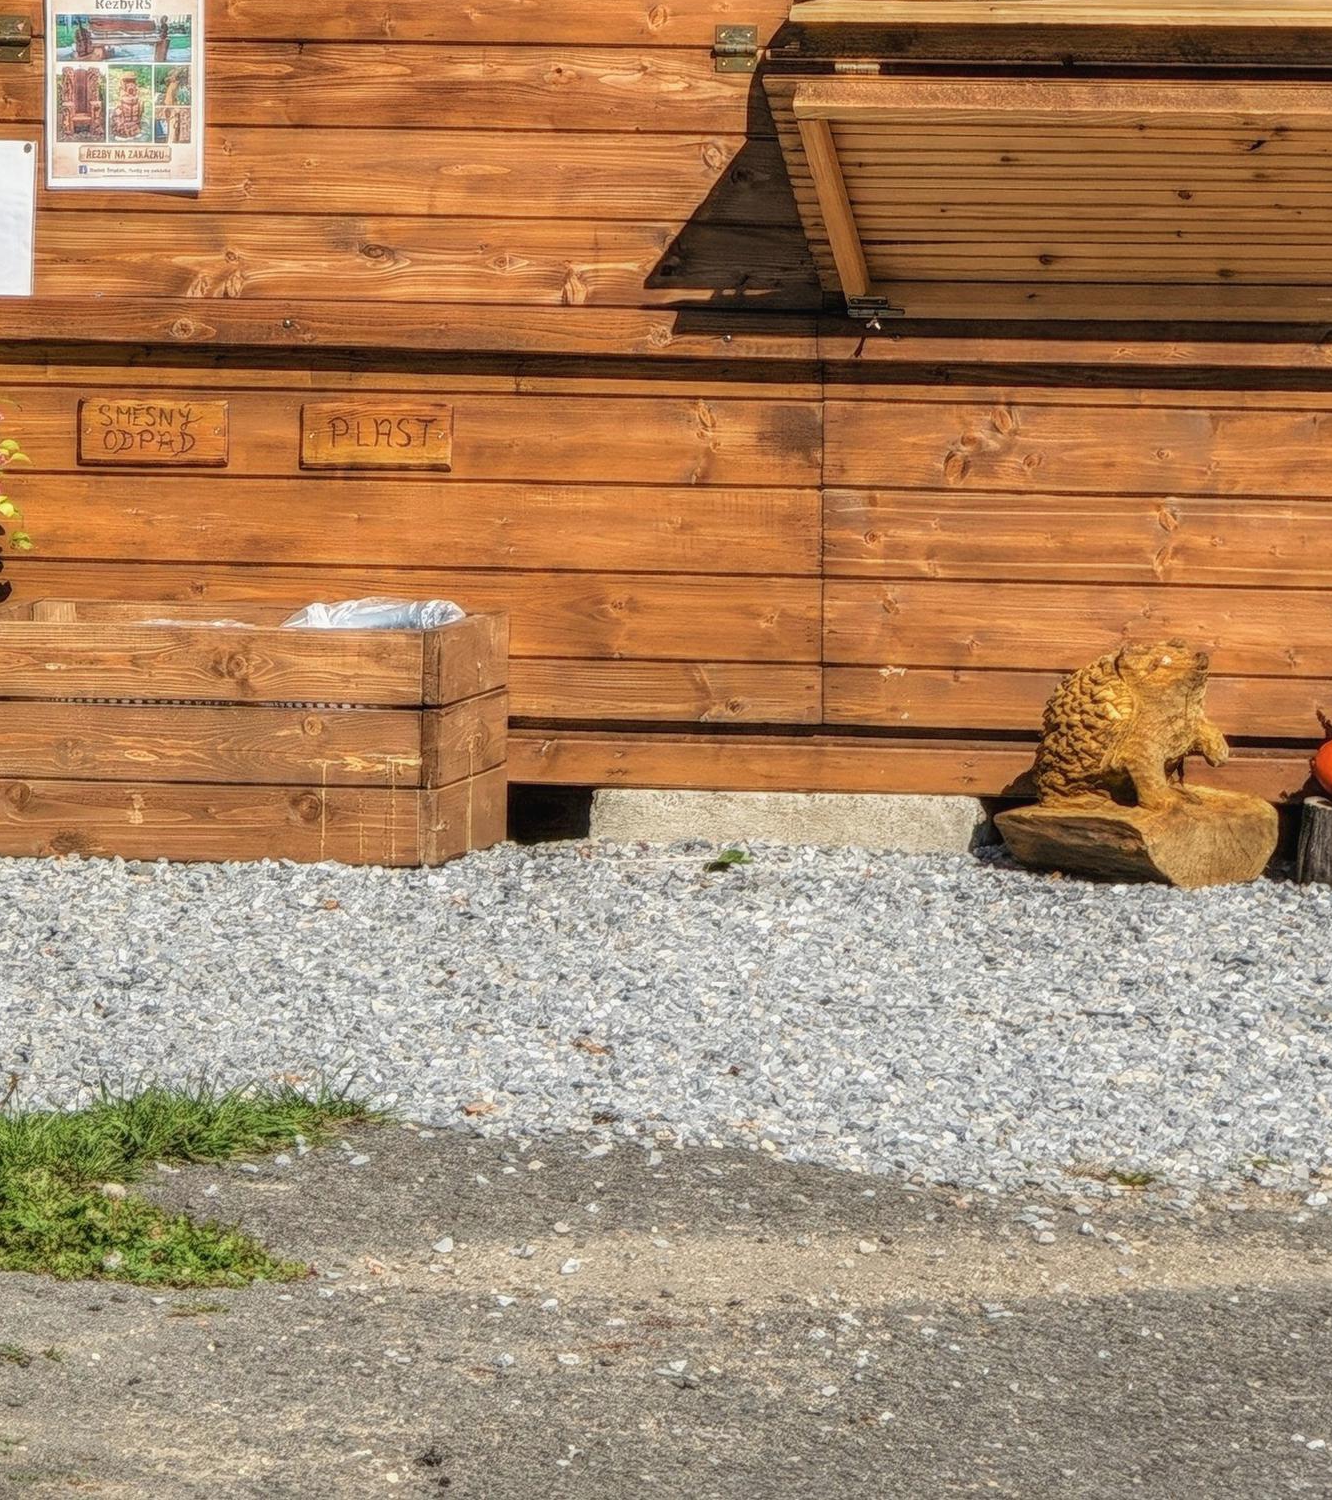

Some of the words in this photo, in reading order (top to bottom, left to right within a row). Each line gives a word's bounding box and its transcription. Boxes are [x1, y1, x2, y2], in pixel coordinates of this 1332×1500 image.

[86, 148, 112, 159] ŘEZBY
[114, 149, 126, 160] NA
[128, 148, 165, 160] ZAKÁZKU
[103, 429, 196, 457] ODPAD
[327, 416, 437, 448] PLAST
